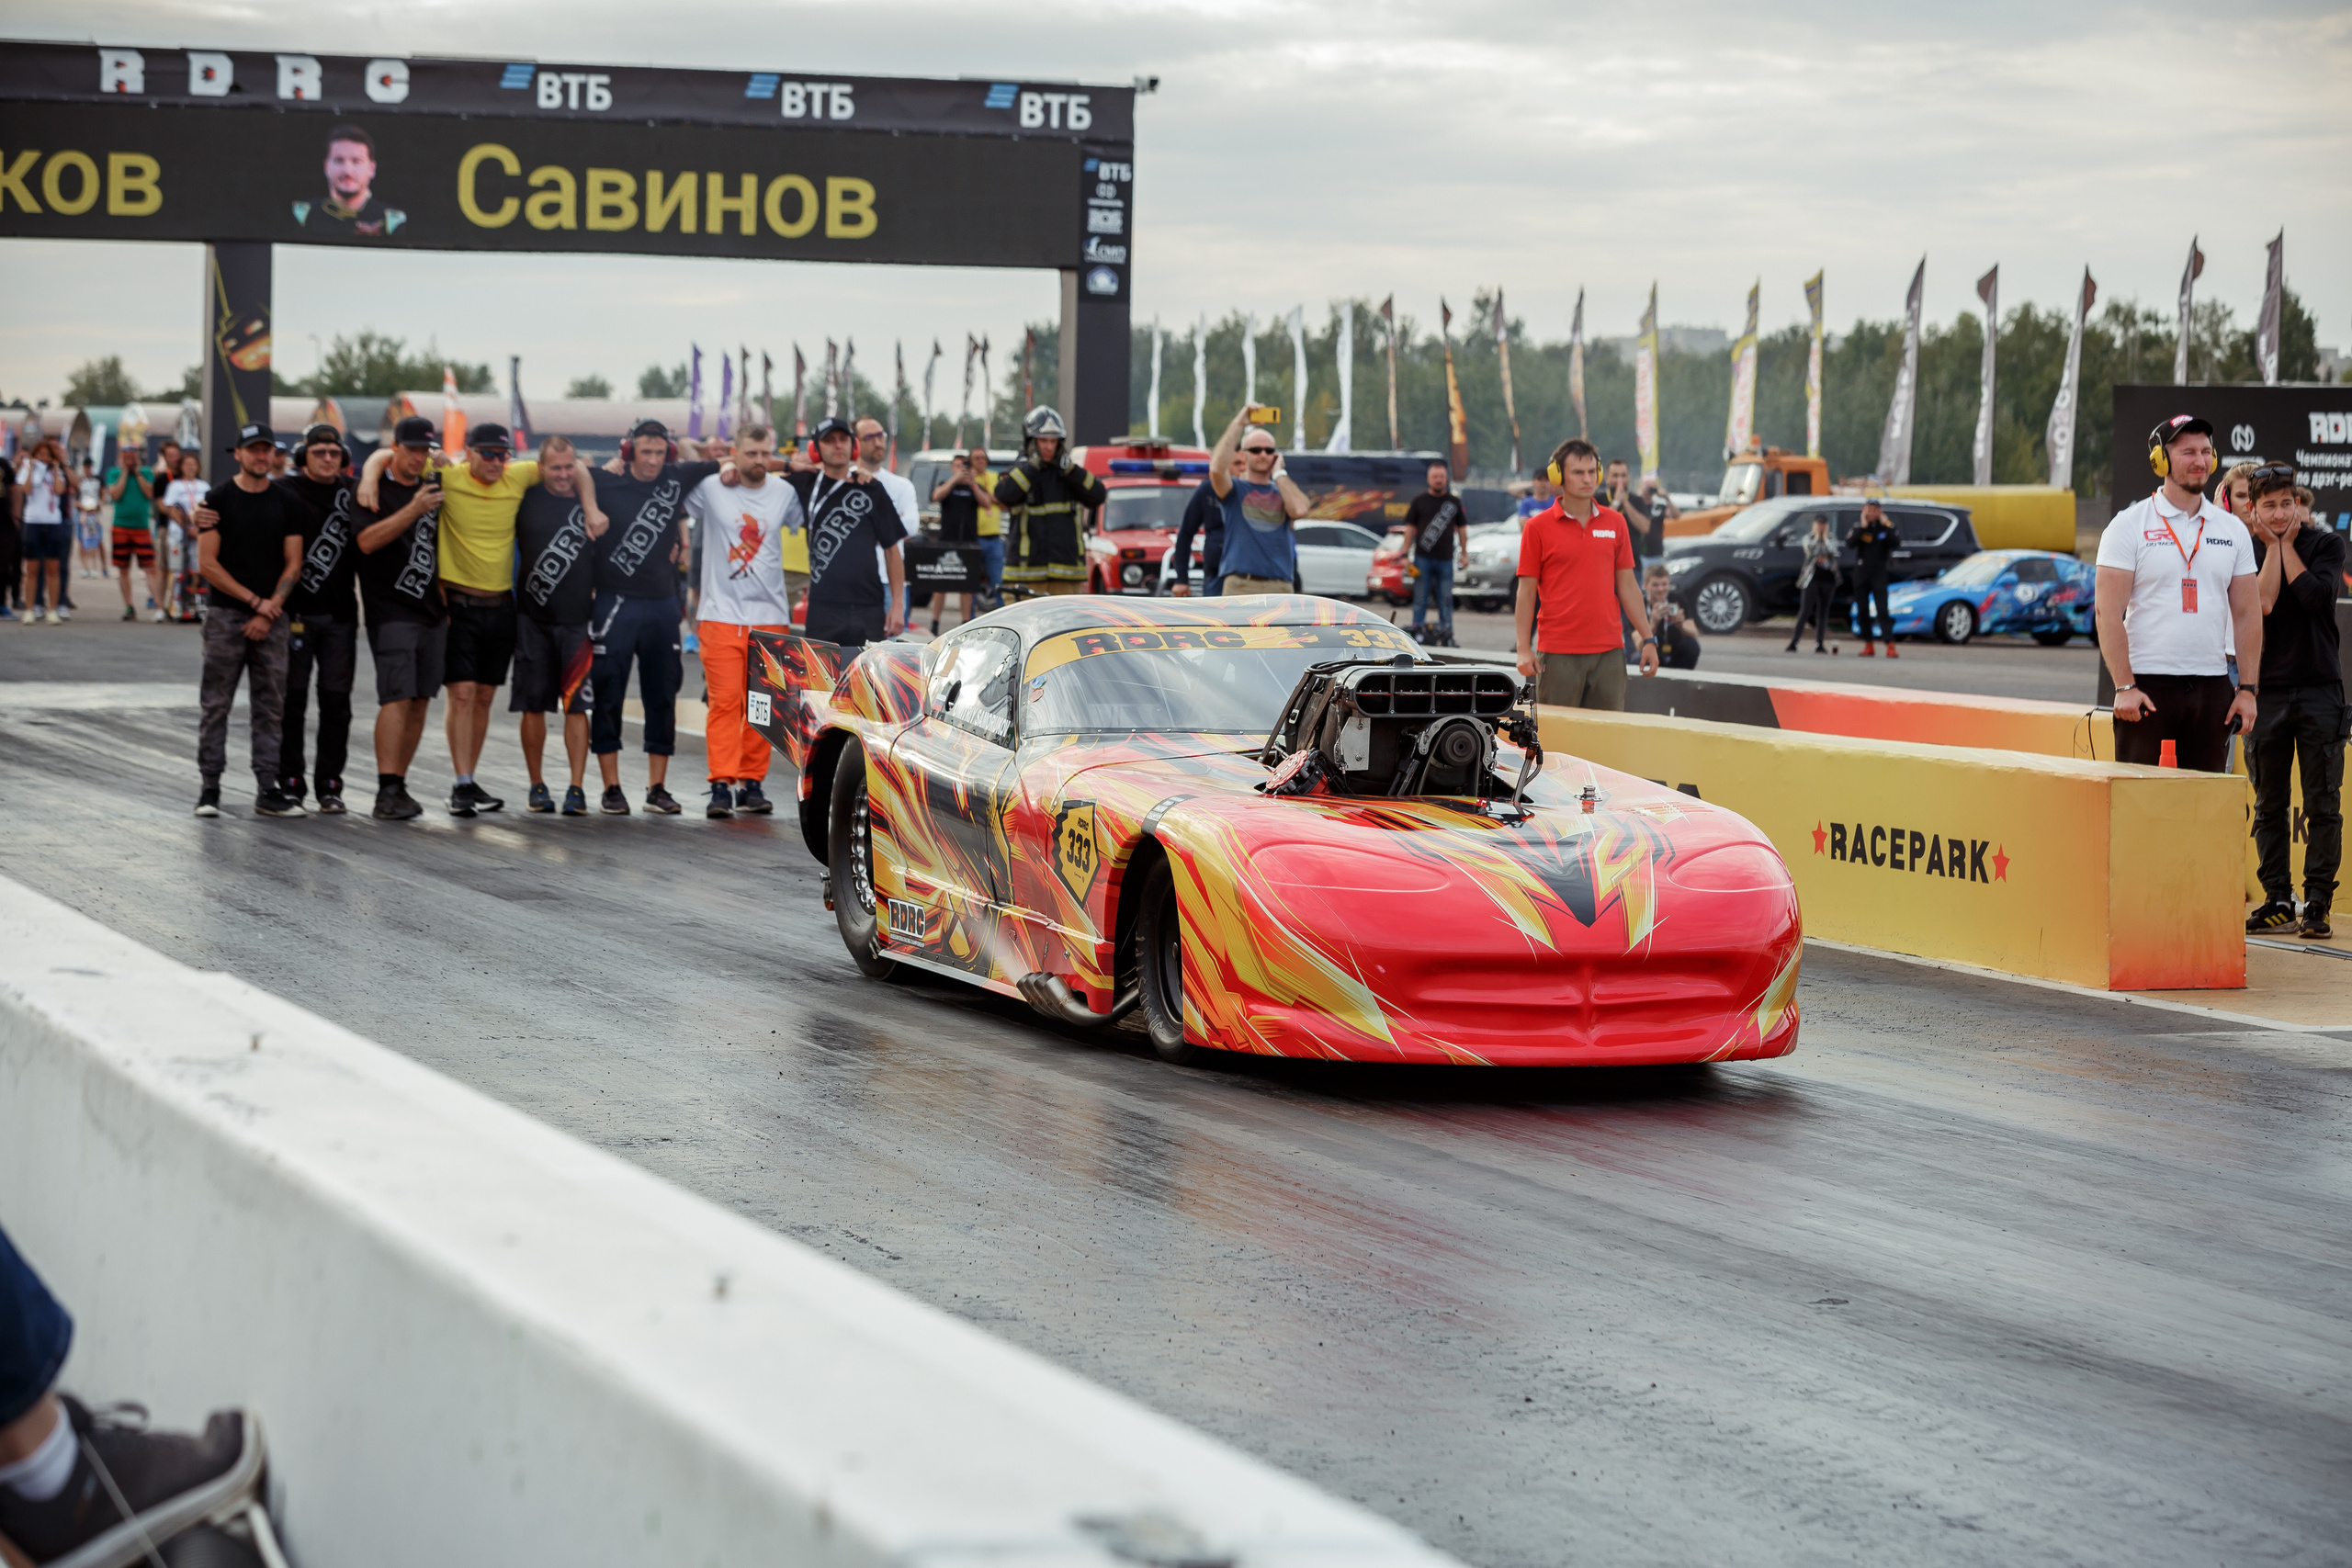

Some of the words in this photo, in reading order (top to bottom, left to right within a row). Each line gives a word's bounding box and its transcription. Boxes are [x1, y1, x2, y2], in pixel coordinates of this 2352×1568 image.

[99, 49, 410, 104] RDRC
[537, 72, 613, 111] ВТБ
[781, 83, 854, 120] ВТБ
[1019, 93, 1092, 130] ВТБ
[457, 142, 878, 240] Савинов
[1099, 162, 1132, 182] ВТБ
[2308, 412, 2352, 444] RD
[2296, 448, 2352, 468] Чемпиона
[610, 479, 681, 577] RDRC
[394, 506, 437, 599] RDR
[1070, 631, 1247, 658] RDRC
[1339, 628, 1419, 655] 333
[756, 700, 768, 721] ВТБ
[1067, 828, 1091, 874] 333
[1830, 822, 1990, 884] RACEPARK
[888, 897, 926, 939] RDRC
